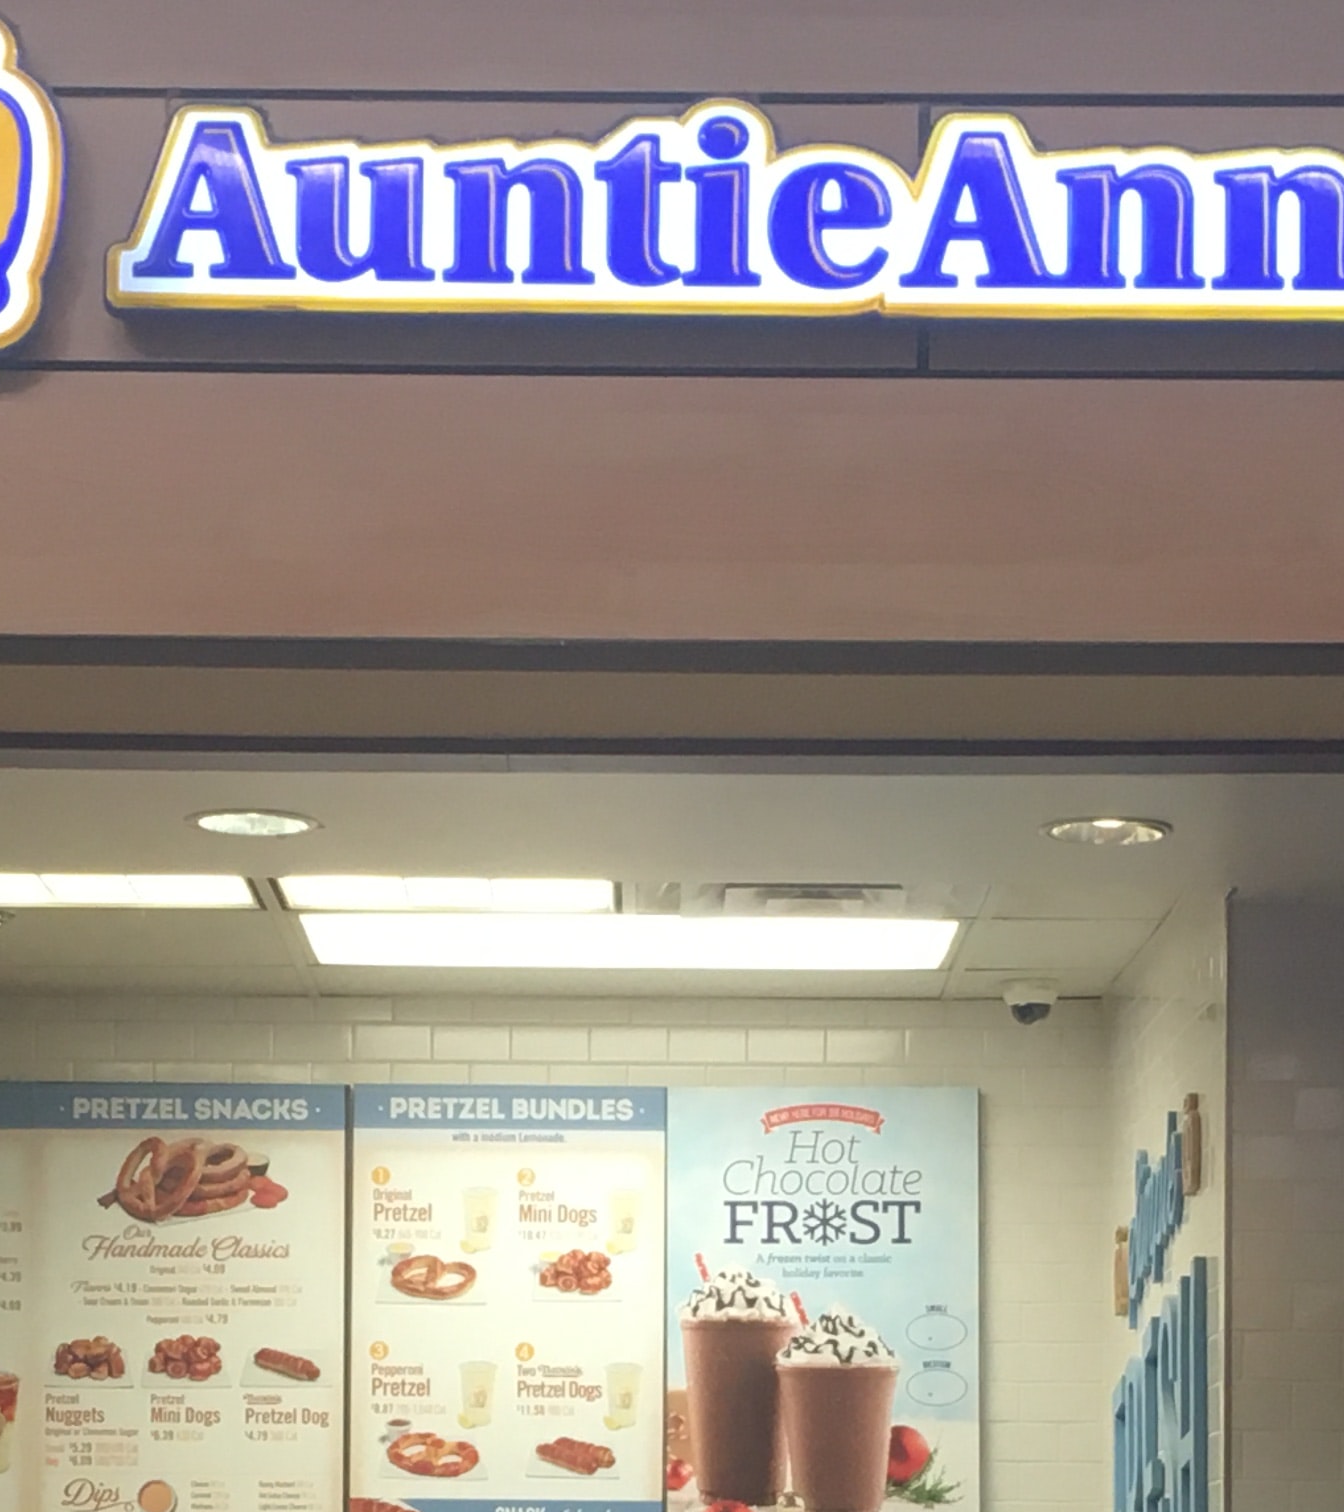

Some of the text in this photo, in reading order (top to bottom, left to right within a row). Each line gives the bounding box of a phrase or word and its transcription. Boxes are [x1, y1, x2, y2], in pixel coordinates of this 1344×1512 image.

[73, 1097, 309, 1120] PRETZEL SNACKS
[390, 1097, 634, 1121] PRETZEL BUNDLES
[784, 1130, 861, 1165] Hot
[722, 1155, 923, 1196] Chocolate
[372, 1188, 413, 1203] Original
[518, 1189, 555, 1202] Pretzel
[372, 1203, 433, 1223] Pretzel
[518, 1205, 598, 1228] Mini Dogs
[81, 1234, 291, 1261] Handmade Classics
[371, 1363, 424, 1378] Pepperoni
[517, 1363, 537, 1377] Two
[371, 1378, 431, 1398] Pretzel
[517, 1380, 604, 1402] Pretzel Dogs
[45, 1406, 105, 1427] Nuggets
[150, 1406, 222, 1428] Mini Dogs
[244, 1407, 330, 1428] Pretzel Dog
[60, 1478, 122, 1512] Dips
